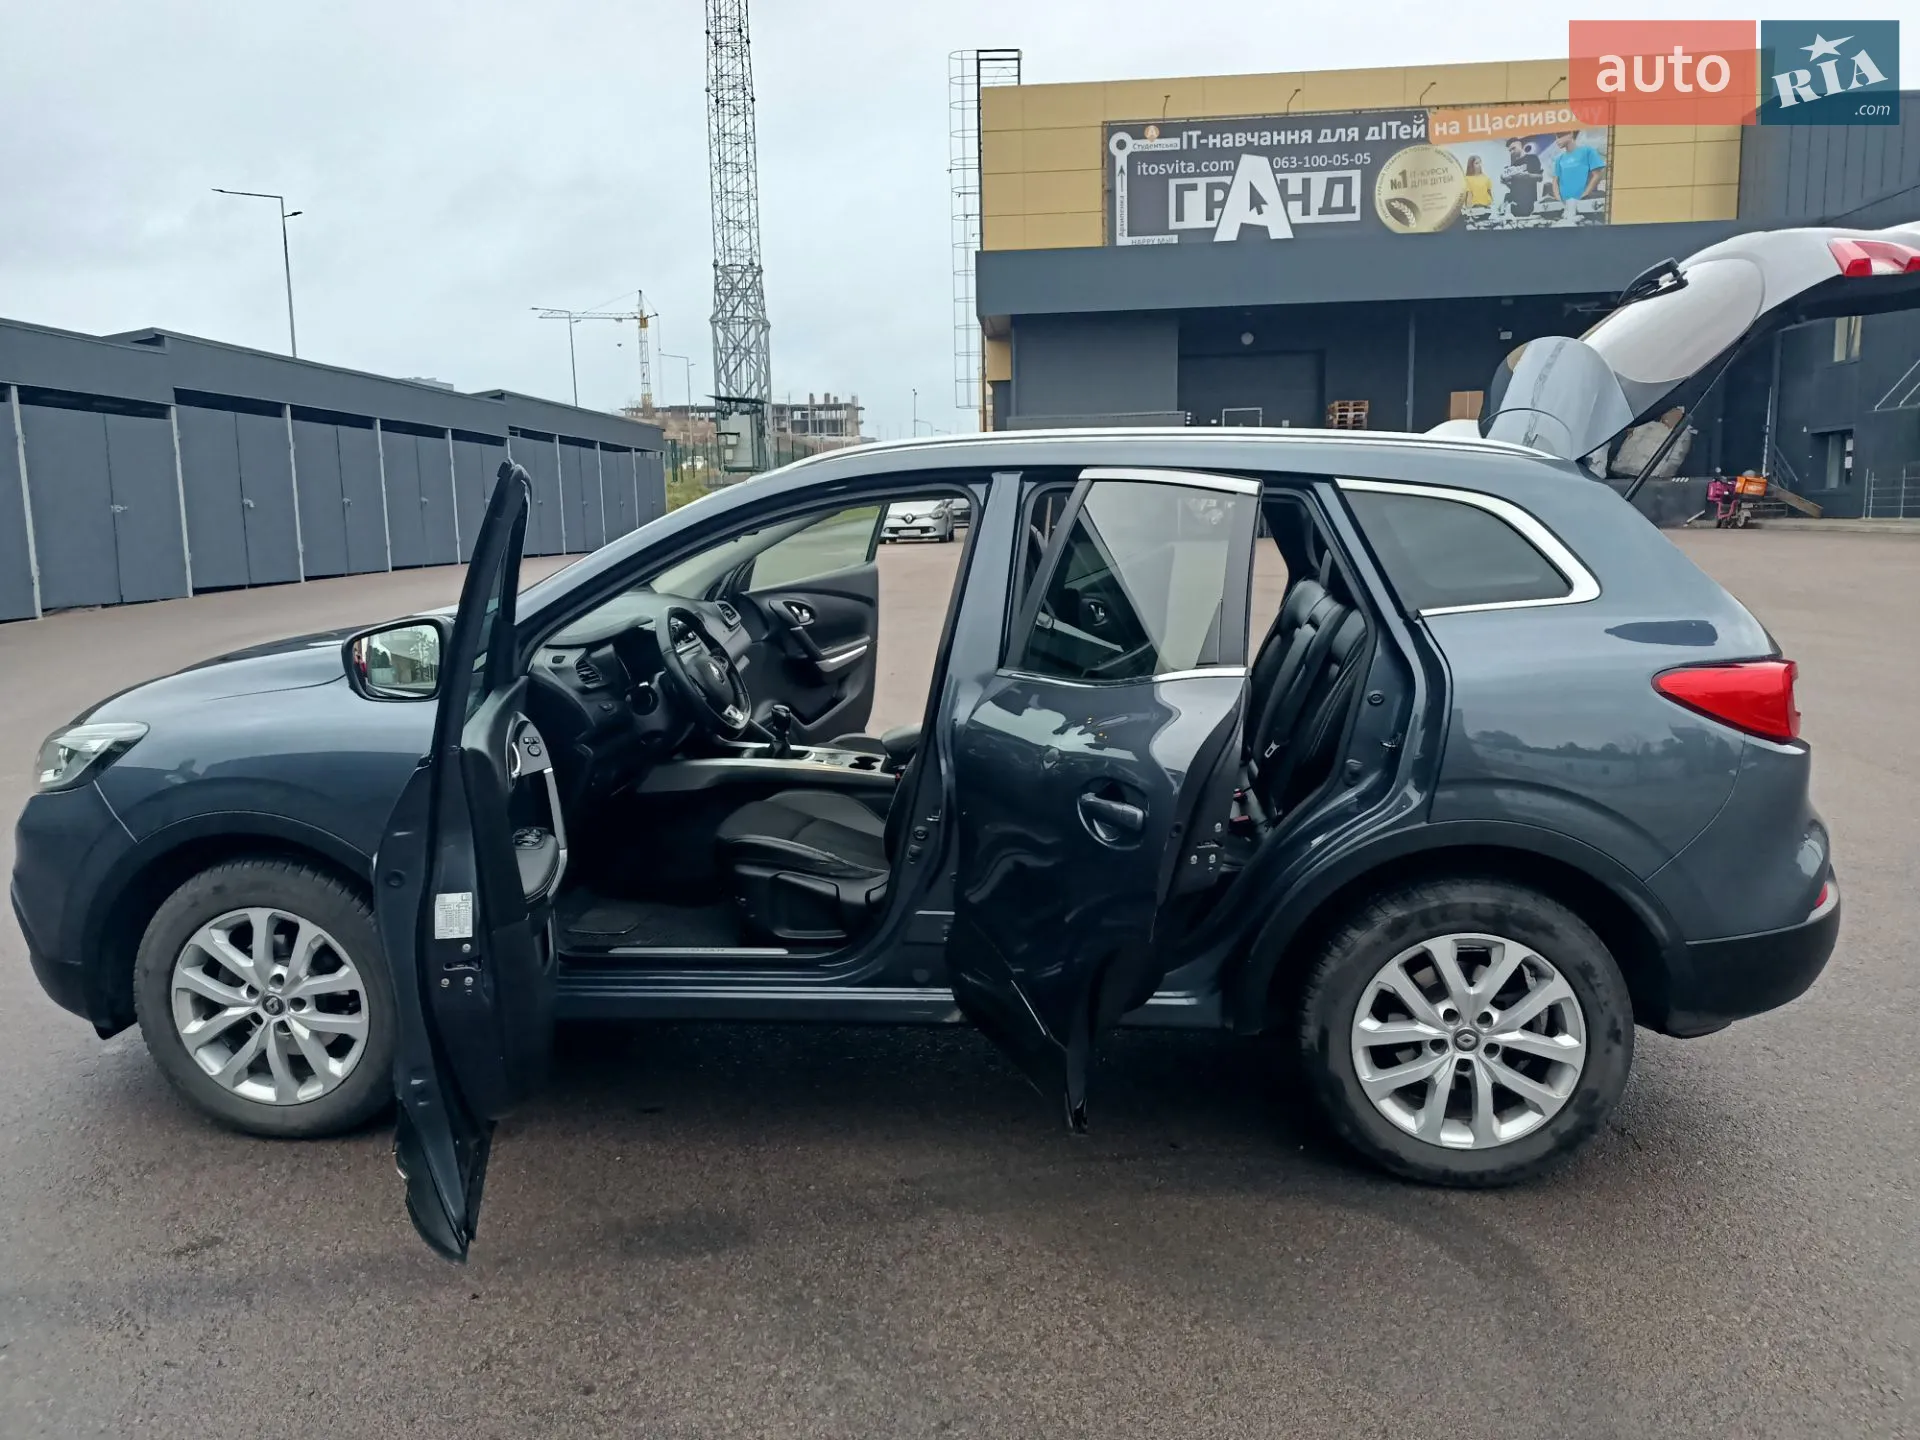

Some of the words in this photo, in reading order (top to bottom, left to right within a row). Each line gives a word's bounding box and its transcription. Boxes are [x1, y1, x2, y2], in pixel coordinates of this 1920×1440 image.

[1182, 129, 1313, 150] ІТ-навчання
[1317, 126, 1360, 144] для
[1434, 121, 1461, 137] на
[1136, 159, 1235, 176] itosvita.com
[1272, 152, 1371, 170] 063-100-05-05
[1174, 153, 1357, 242] ГРАНД
